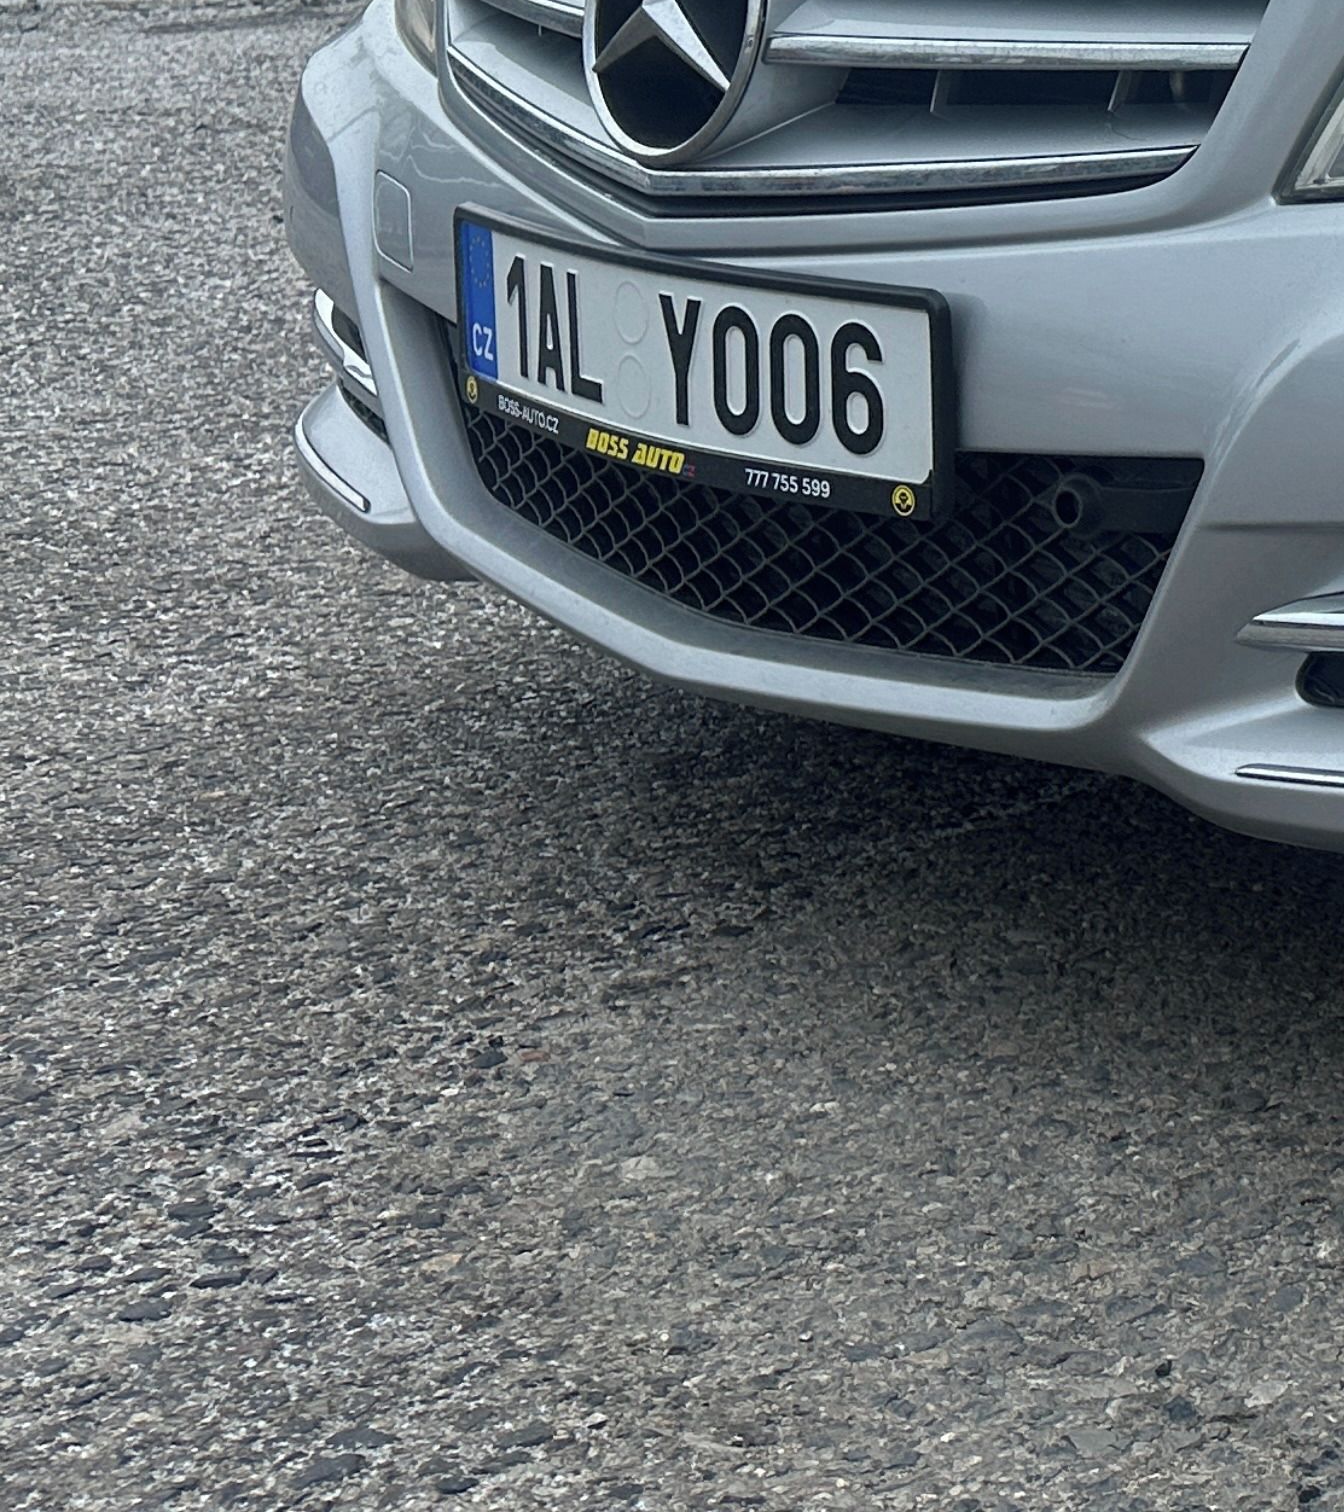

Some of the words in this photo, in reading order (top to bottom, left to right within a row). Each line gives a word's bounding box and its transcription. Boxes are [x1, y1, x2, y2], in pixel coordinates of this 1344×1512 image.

[472, 322, 494, 361] CZ
[507, 255, 603, 404] 1AL
[659, 292, 884, 455] Y006
[498, 394, 559, 434] BOSS-AUTO.CZ
[586, 428, 629, 459] BOSS
[632, 443, 685, 474] AUTO
[745, 468, 769, 488] 777
[772, 473, 798, 493] 755
[801, 478, 831, 498] 599
